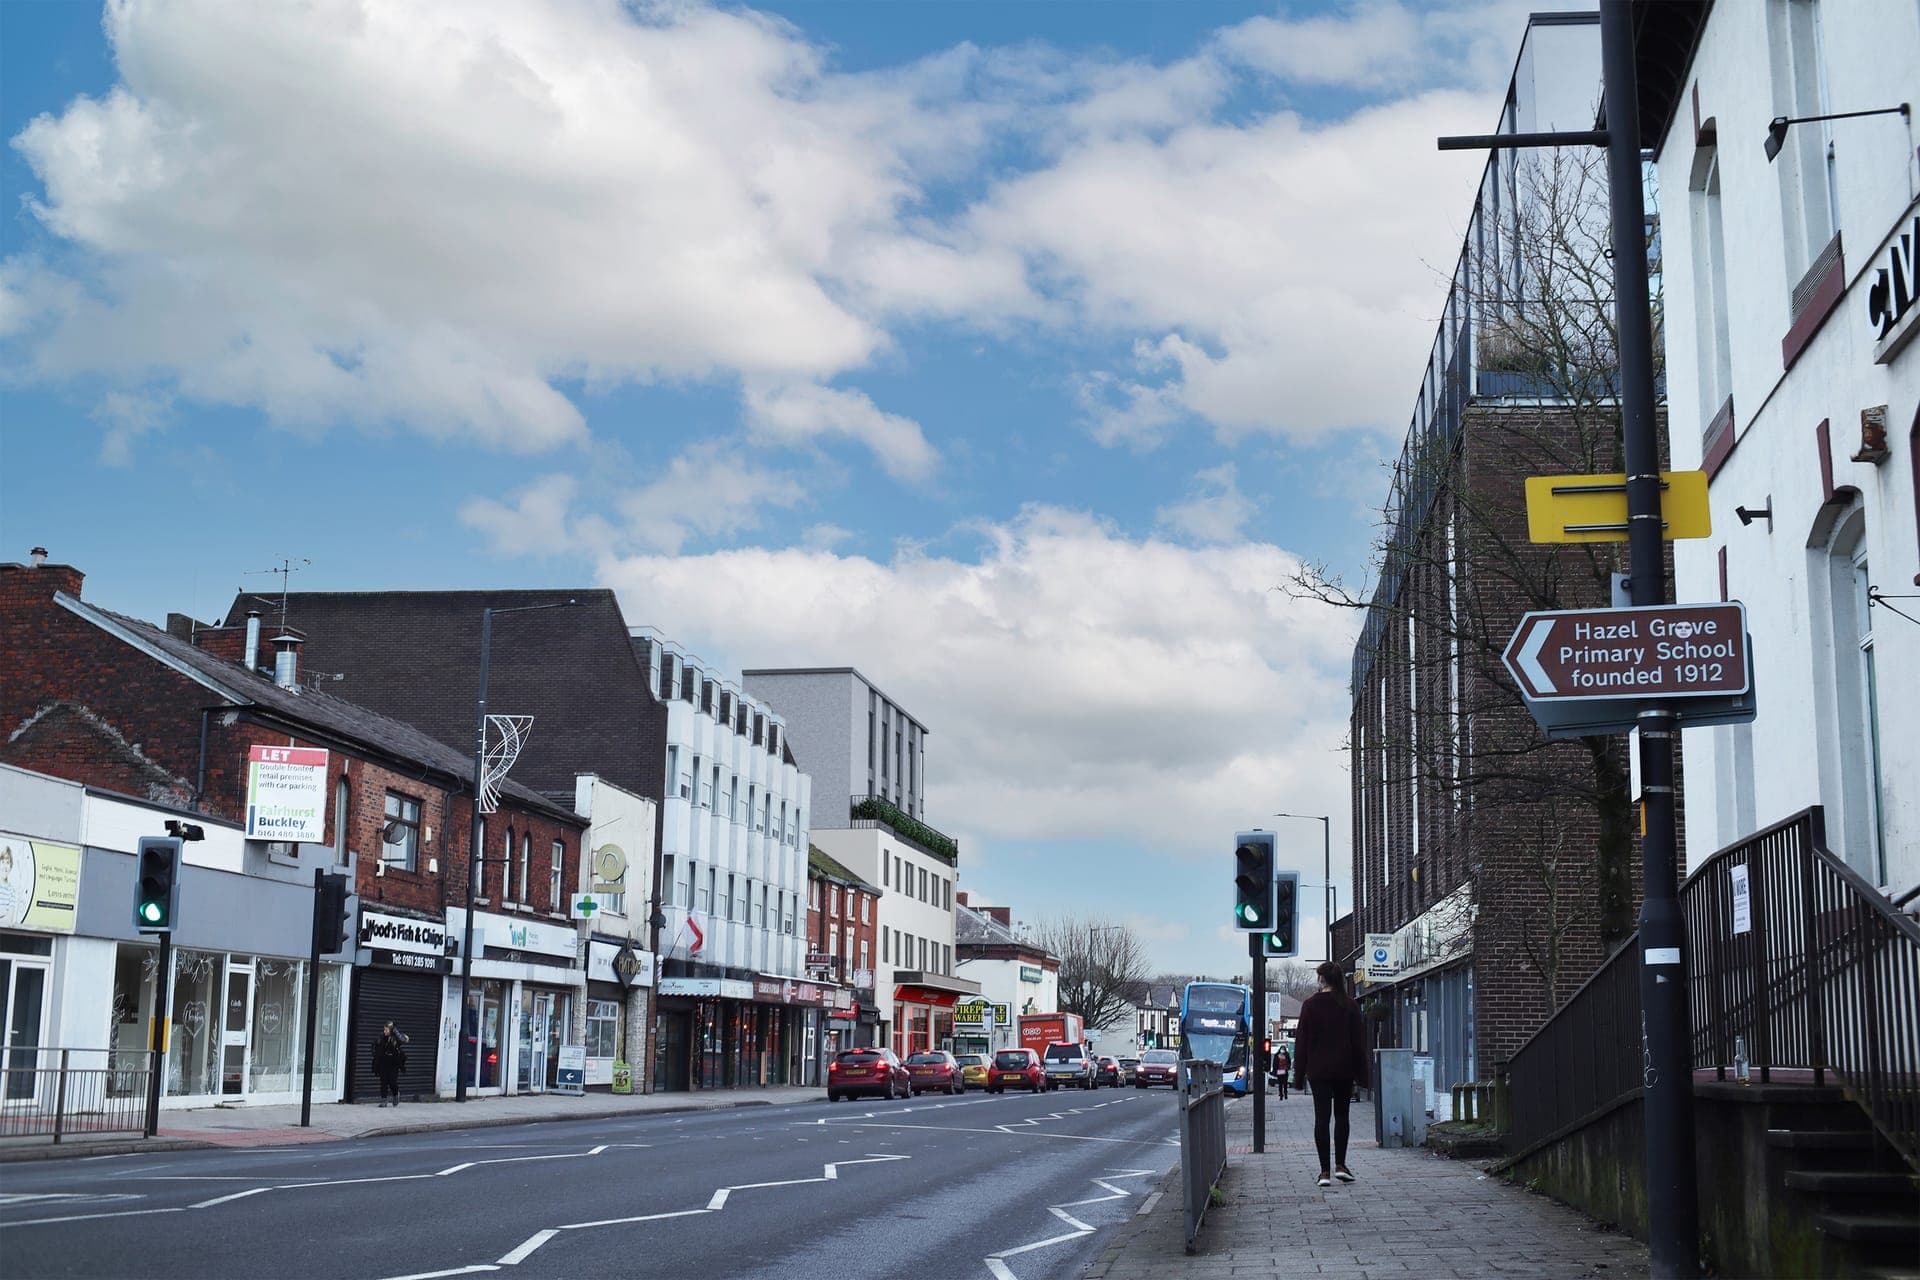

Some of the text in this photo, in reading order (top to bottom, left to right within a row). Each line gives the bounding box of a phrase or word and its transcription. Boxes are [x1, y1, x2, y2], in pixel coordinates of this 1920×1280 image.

[1575, 618, 1717, 641] Hazel Grve
[1560, 639, 1735, 665] Primary School
[1571, 663, 1723, 687] founded 1912
[261, 748, 290, 762] LET
[289, 784, 318, 792] parking
[260, 804, 316, 817] Fairhurst
[258, 817, 306, 830] Buckley
[366, 918, 444, 950] Wood's Fish & Chips
[402, 954, 414, 966] 0161
[954, 1005, 1005, 1014] FIREPE
[954, 1013, 1005, 1022] WAREHSE
